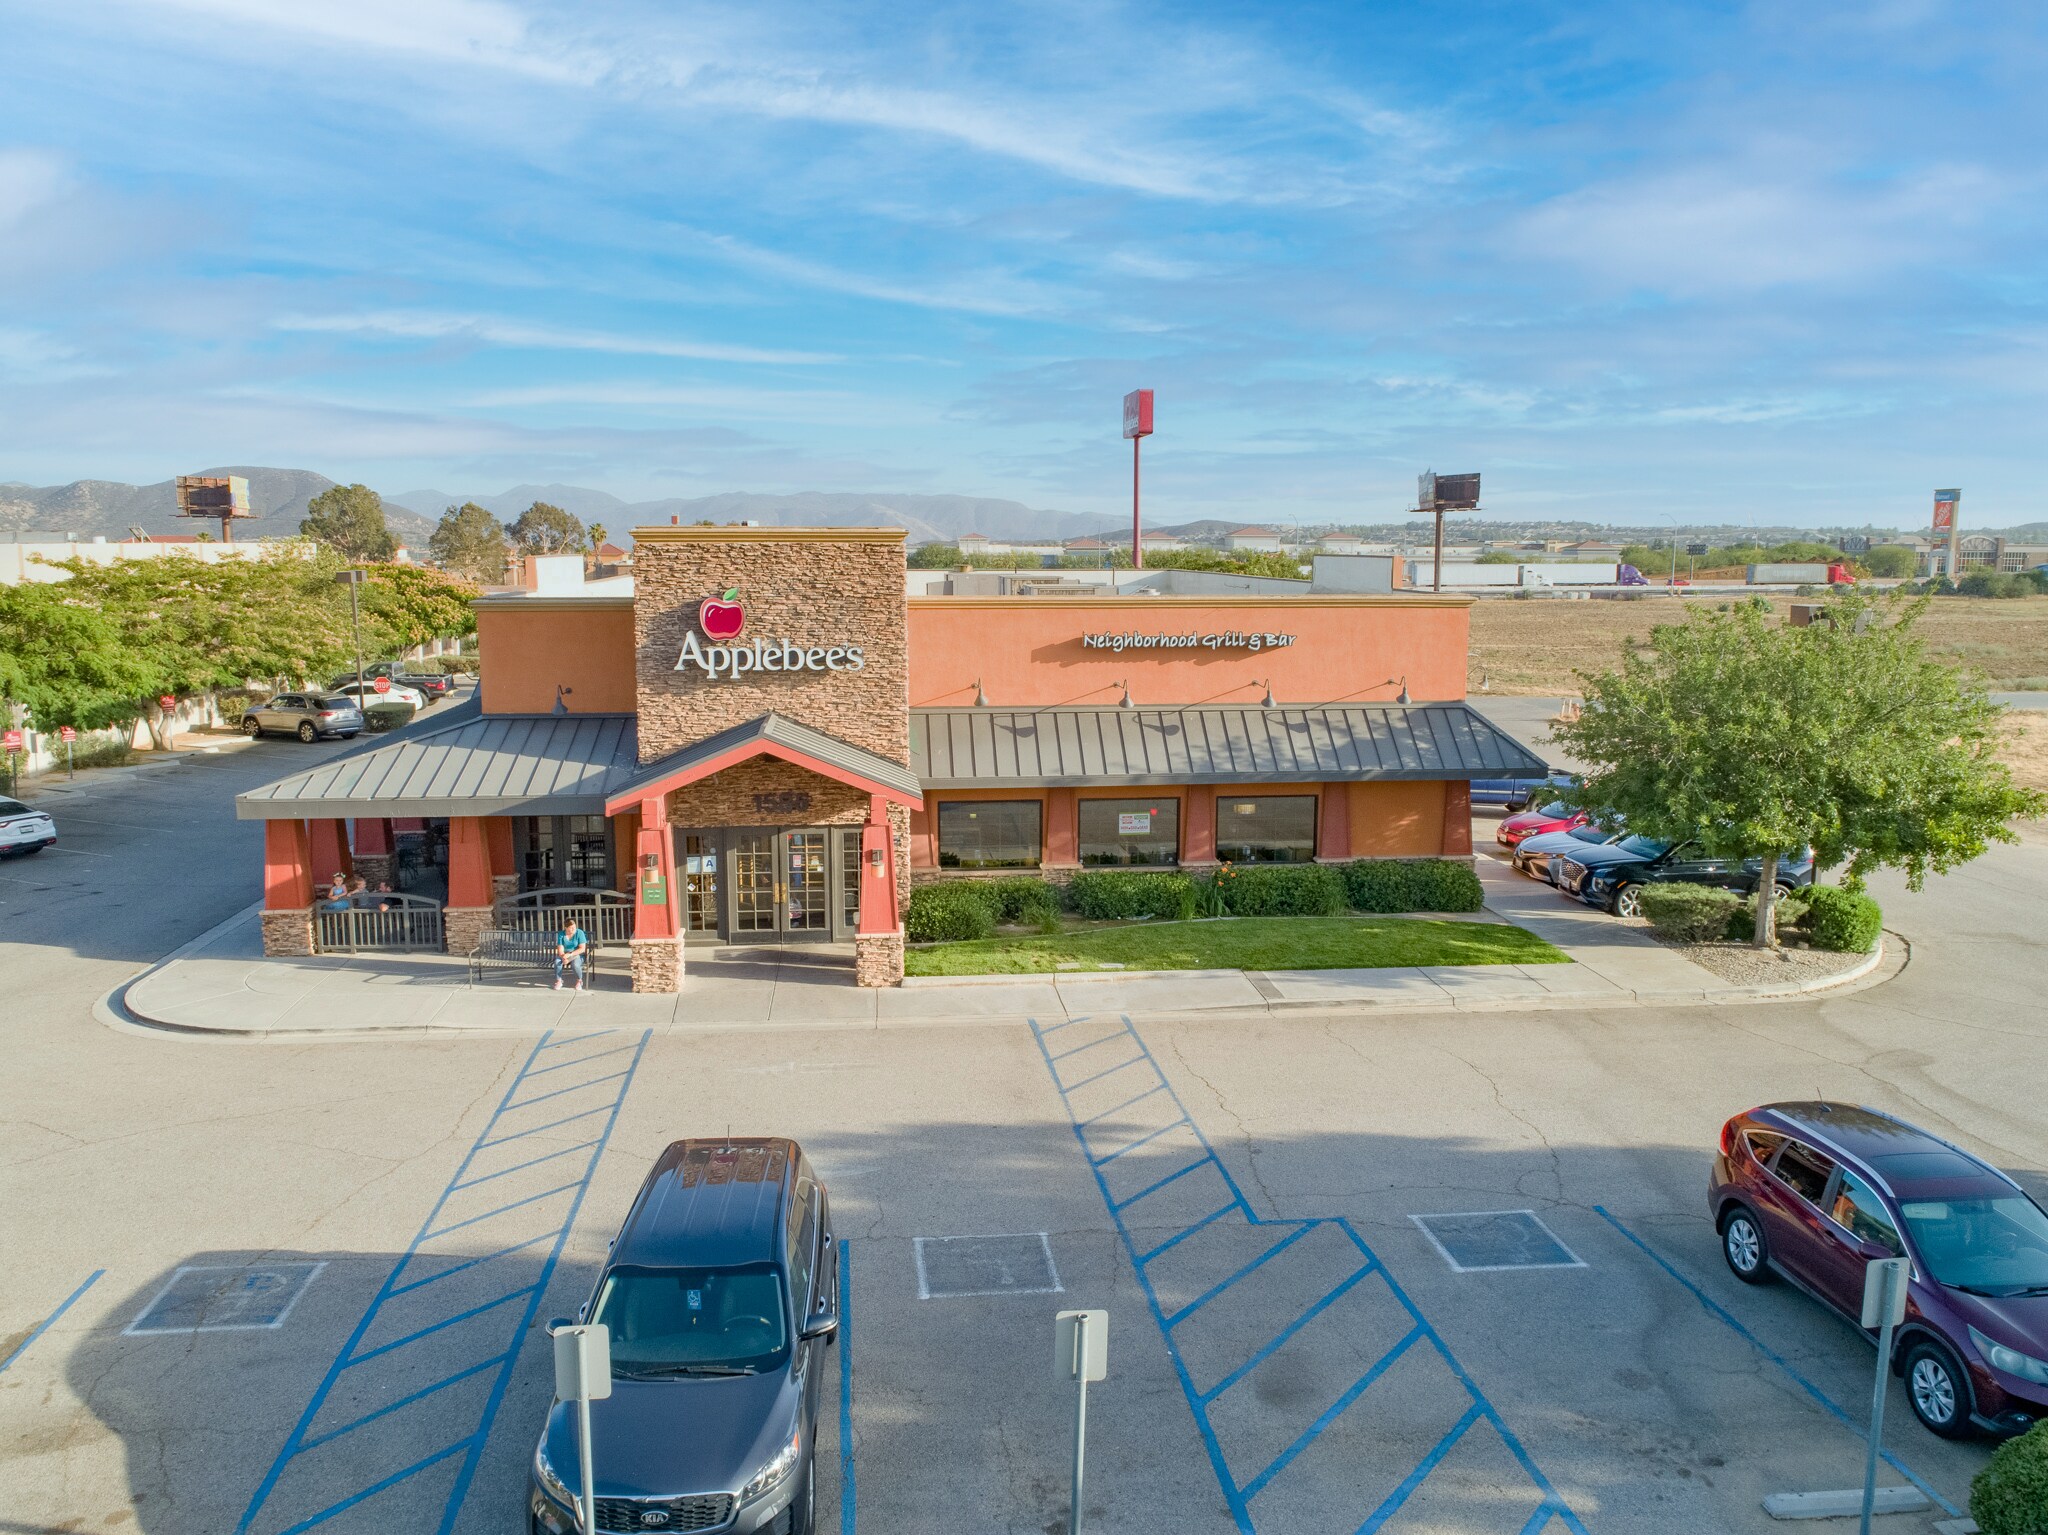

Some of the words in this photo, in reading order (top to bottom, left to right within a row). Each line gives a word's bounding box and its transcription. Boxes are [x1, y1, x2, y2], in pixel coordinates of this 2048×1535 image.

[1083, 631, 1198, 652] Neighborhood
[1202, 630, 1246, 650] Grill
[1248, 632, 1261, 650] &
[1263, 632, 1297, 647] Bar
[674, 630, 864, 679] Applebee's
[374, 681, 391, 689] STOP
[706, 859, 714, 867] A
[645, 1514, 664, 1523] KIA
